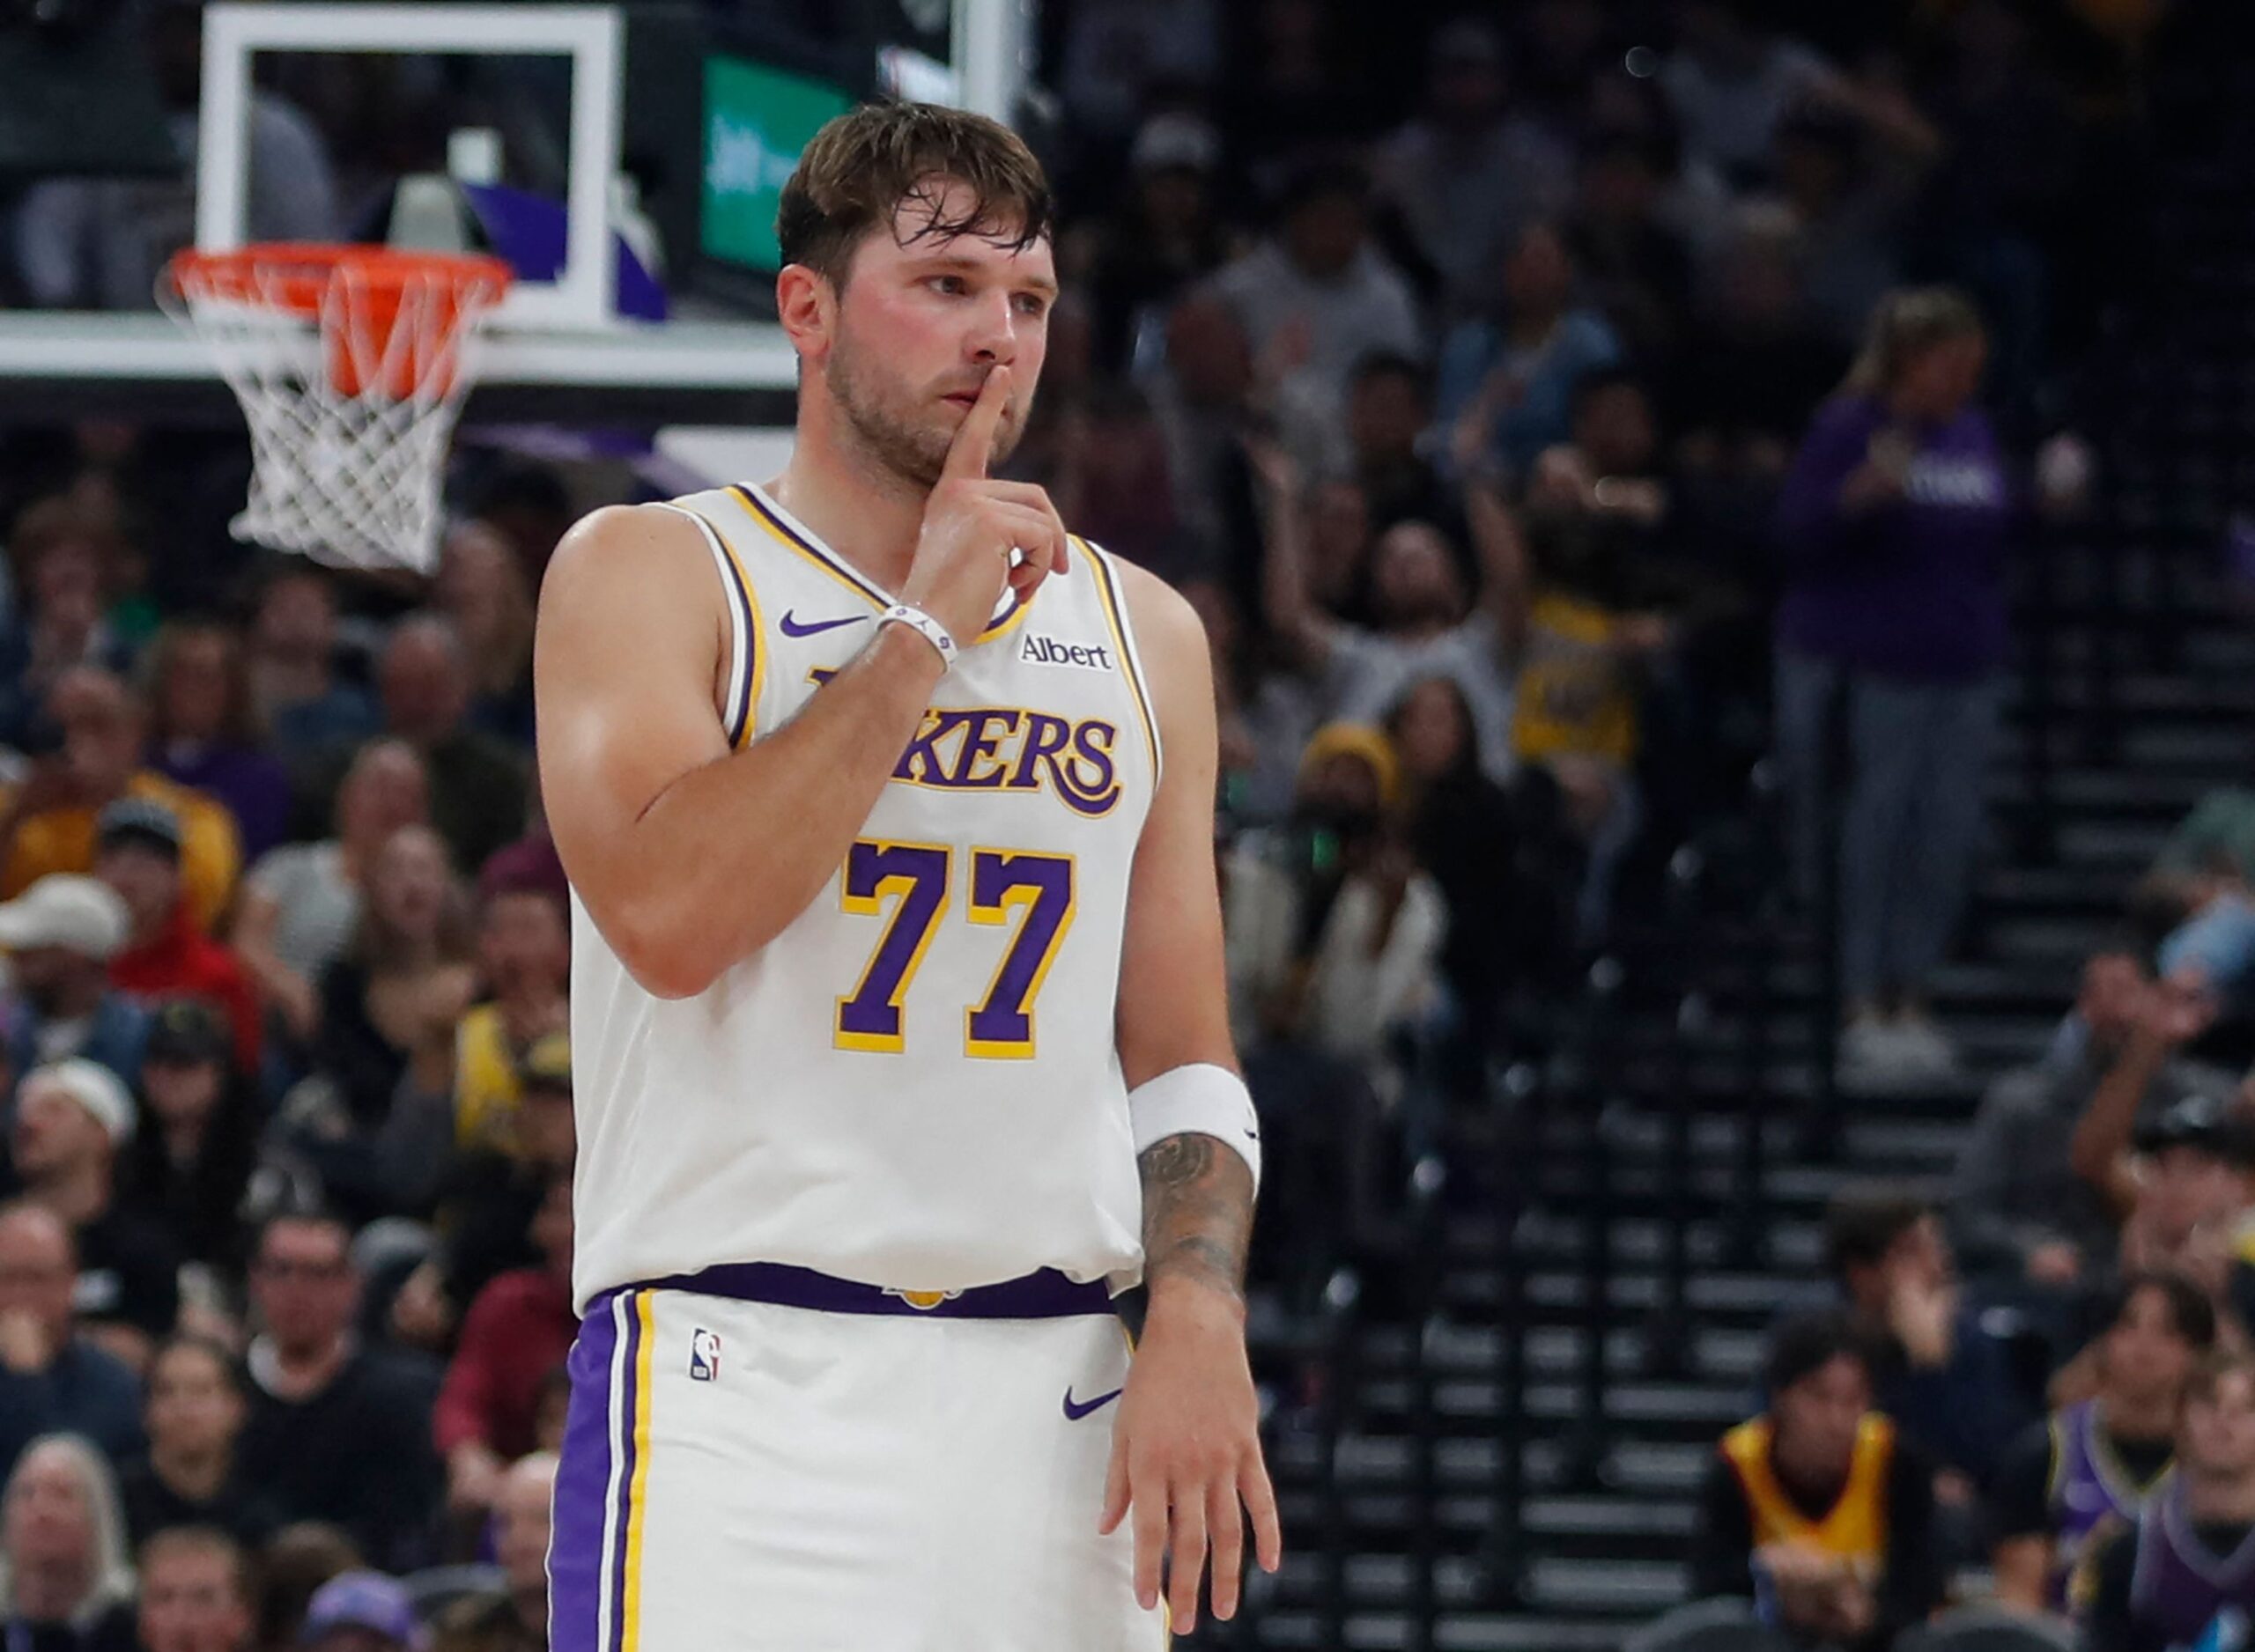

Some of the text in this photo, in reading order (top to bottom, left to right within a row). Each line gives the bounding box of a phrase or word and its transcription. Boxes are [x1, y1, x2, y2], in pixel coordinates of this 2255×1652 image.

[1021, 633, 1112, 669] Albert
[805, 666, 1123, 819] KERS
[833, 837, 1077, 1059] 77
